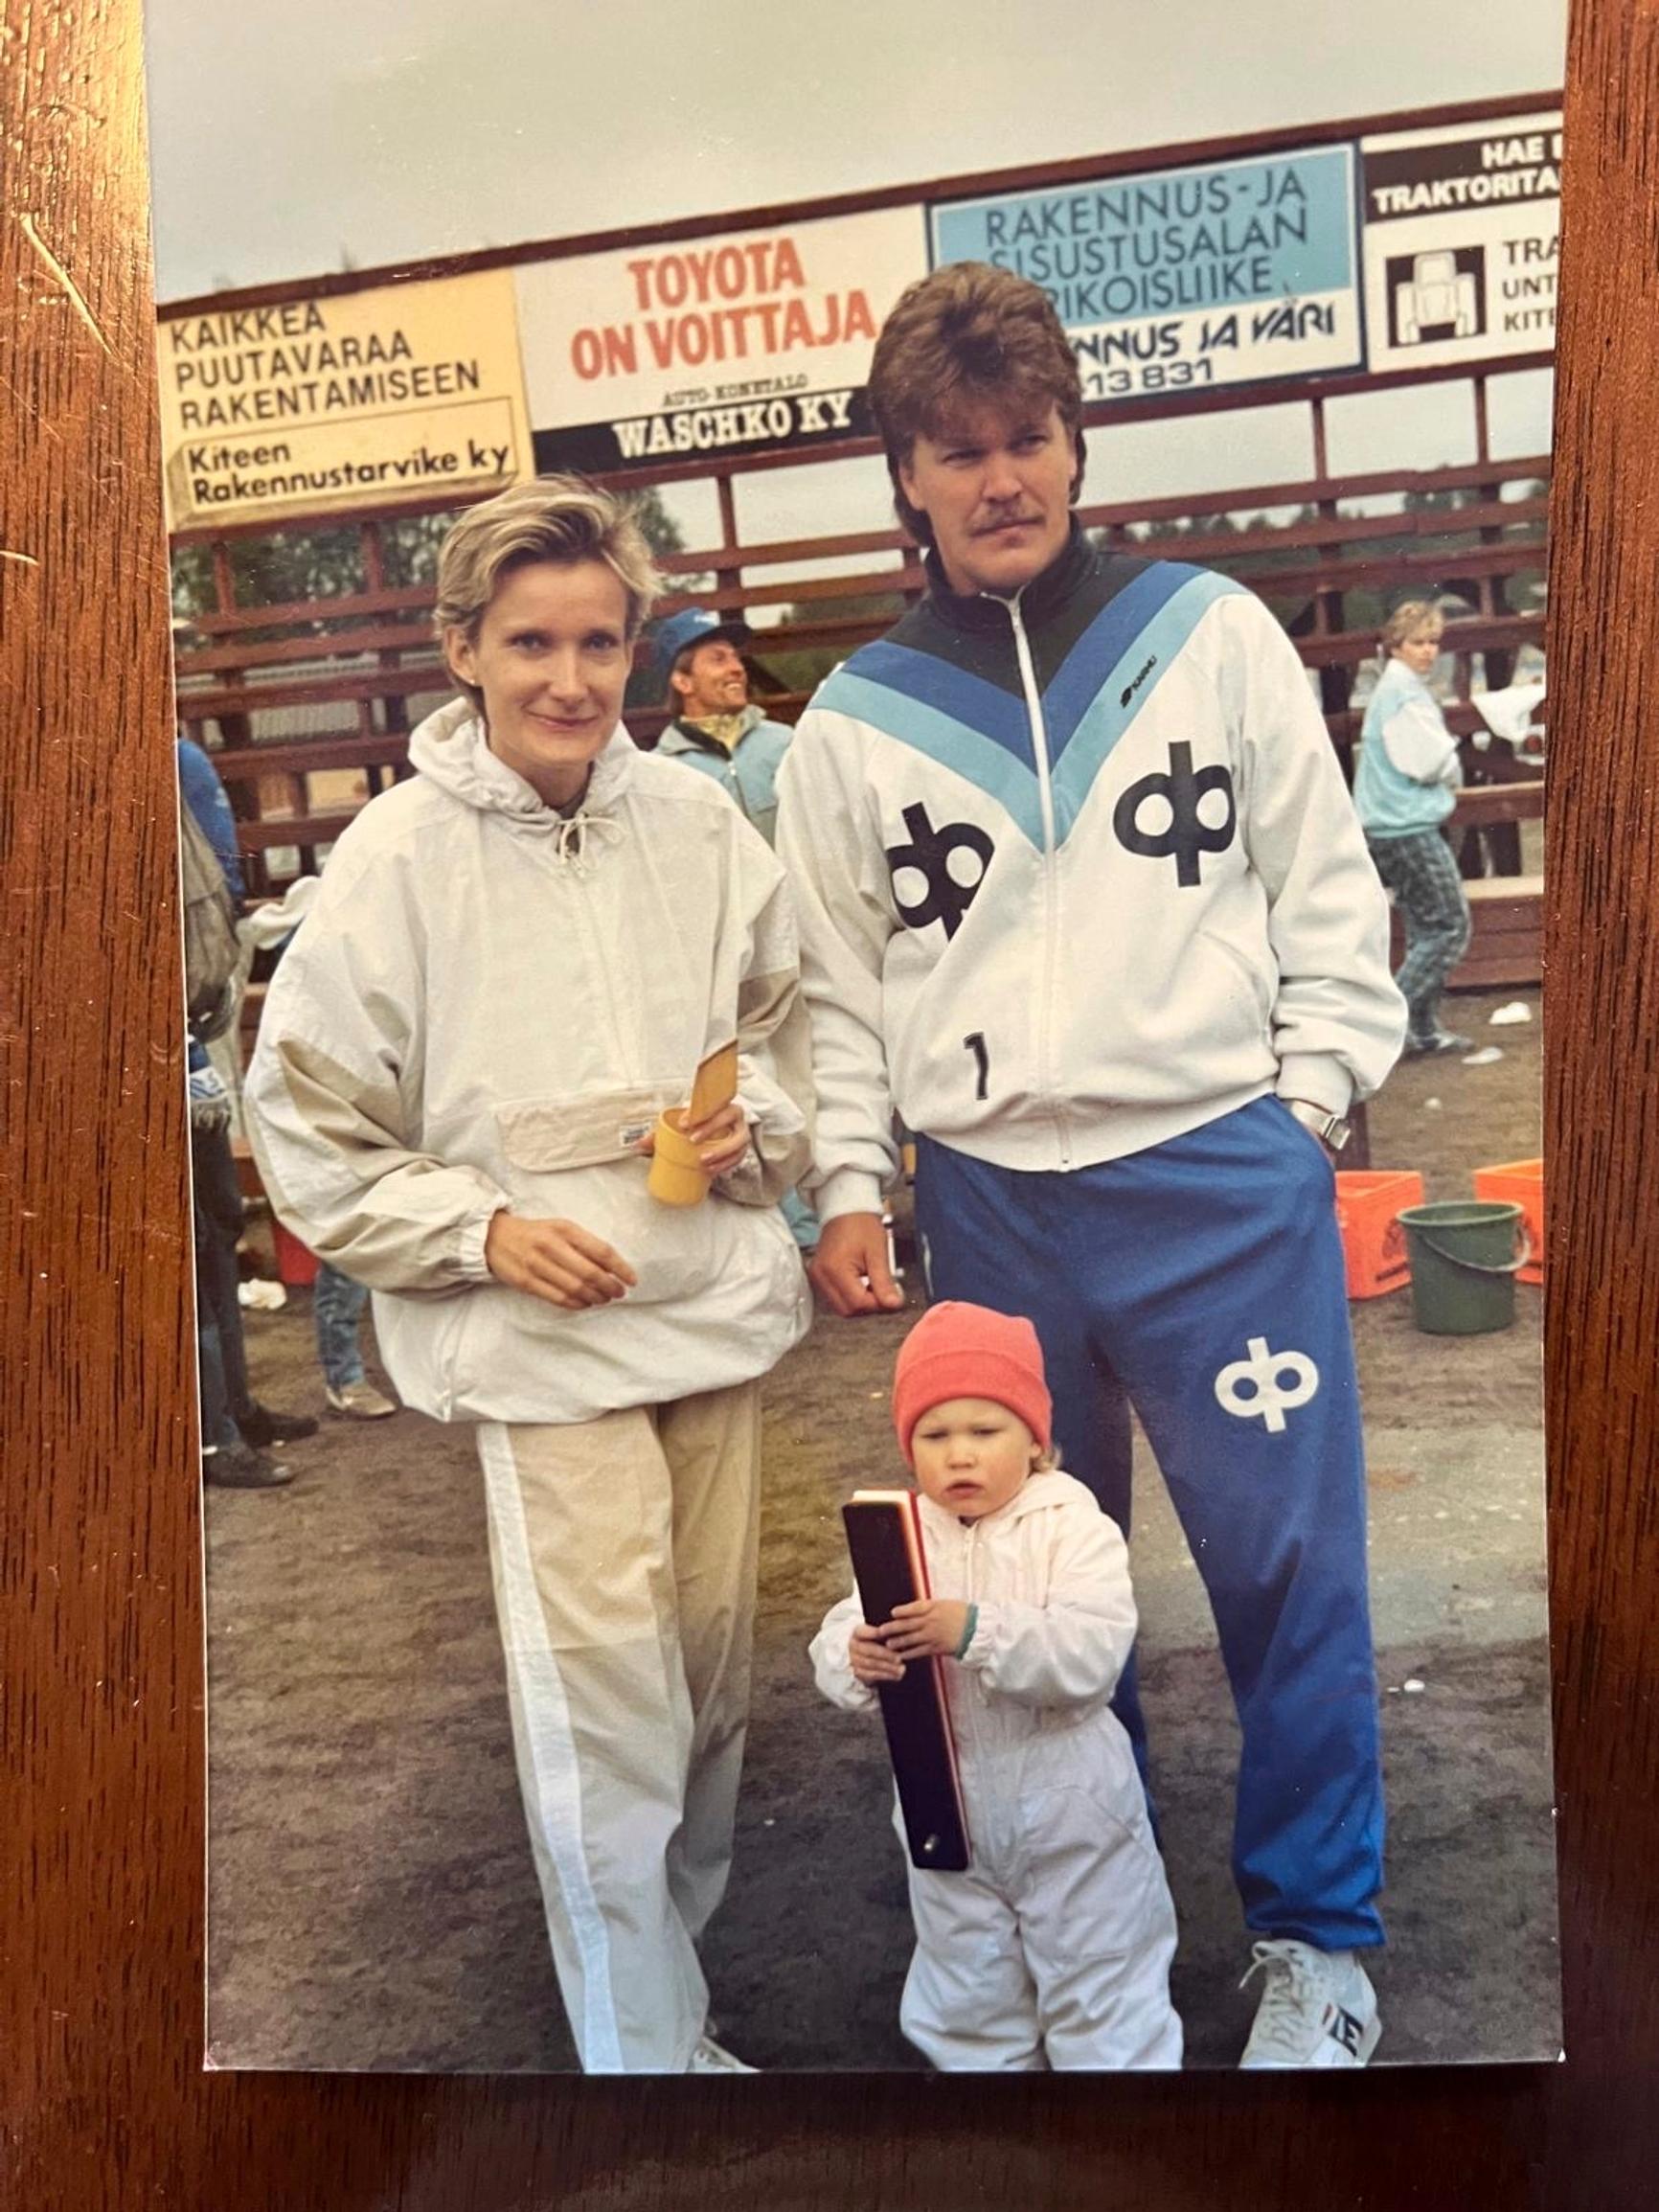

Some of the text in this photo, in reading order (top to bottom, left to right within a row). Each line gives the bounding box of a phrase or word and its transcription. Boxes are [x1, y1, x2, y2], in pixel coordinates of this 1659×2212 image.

[1482, 136, 1545, 169] HAE
[627, 238, 807, 311] TOYOTA
[1502, 273, 1557, 300] UNT
[170, 303, 327, 353] KAIKKEA
[572, 290, 877, 380] ON VOITTAJA
[1072, 322, 1184, 366] NNUS
[1199, 313, 1239, 353] JA
[176, 330, 413, 393] PUUTAVARAA
[1143, 357, 1216, 391] 831
[180, 359, 480, 430] RAKENTAMISEEN
[612, 390, 853, 459] WASCHKO KY
[189, 442, 291, 473] Kiteen
[194, 440, 510, 504] Rakennustarvike ky
[963, 1031, 989, 1101] 1
